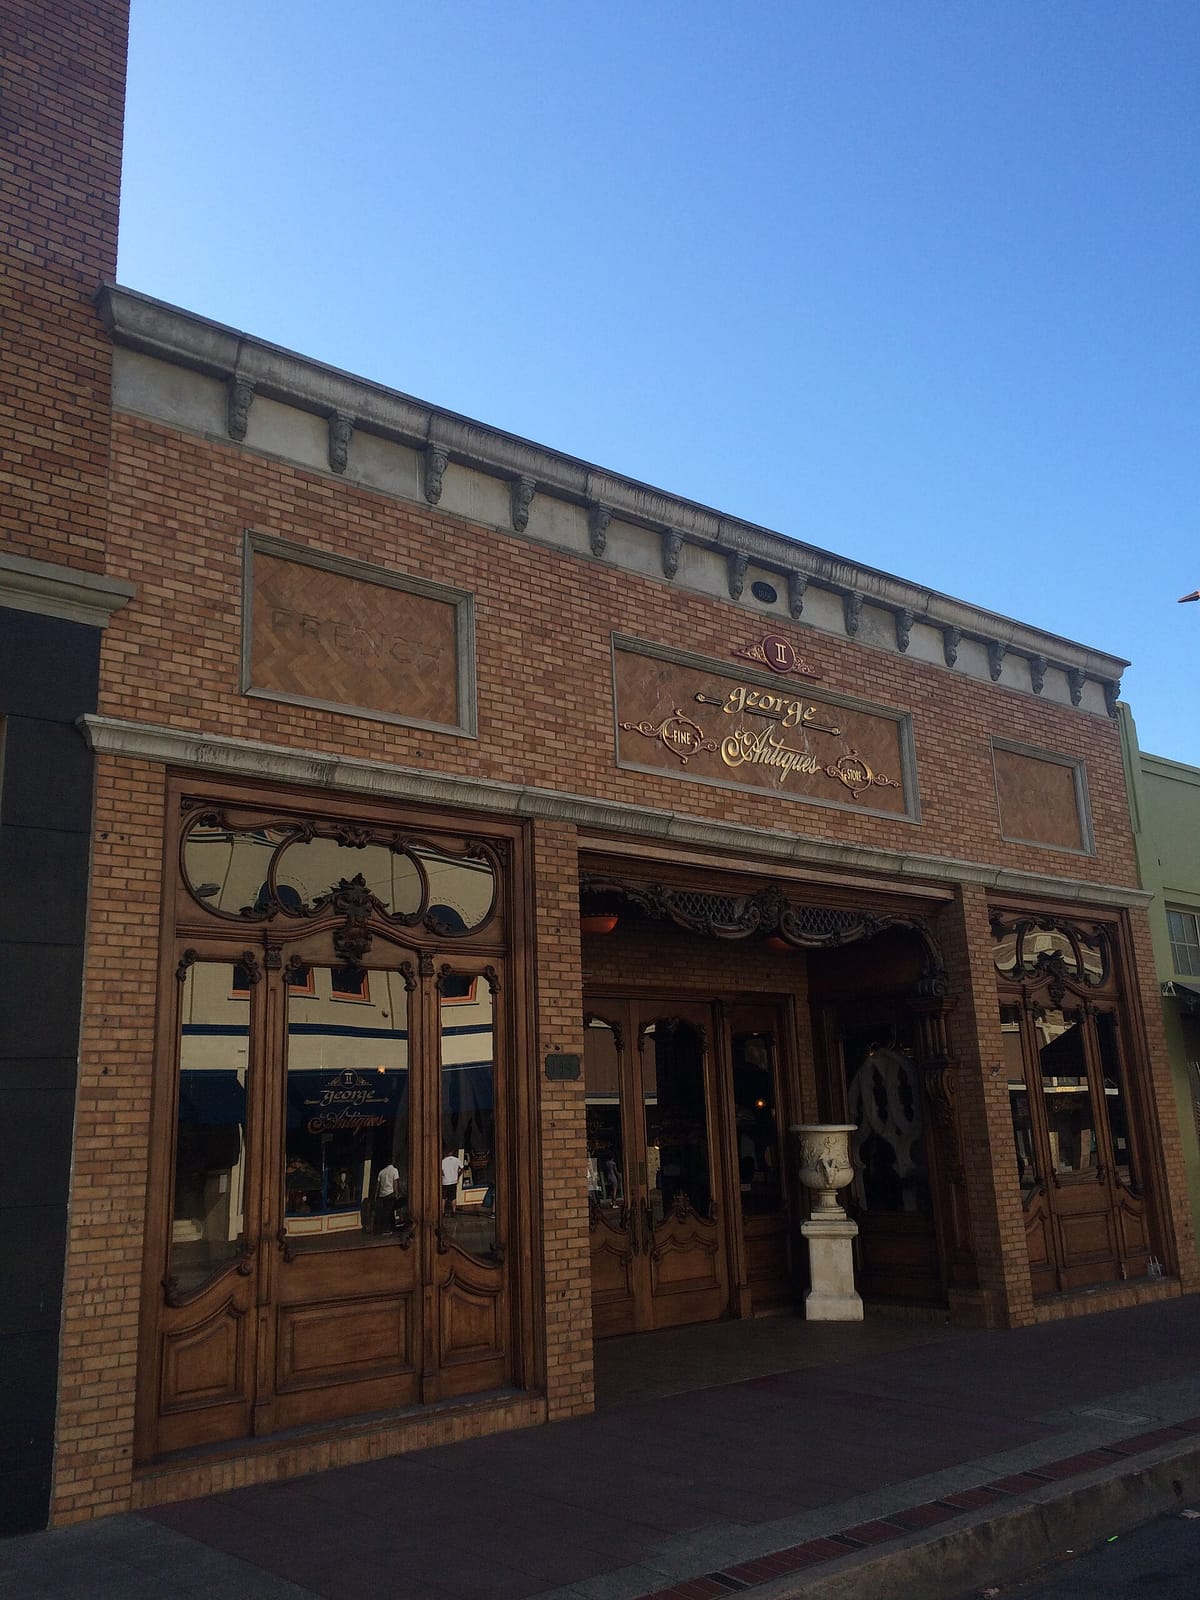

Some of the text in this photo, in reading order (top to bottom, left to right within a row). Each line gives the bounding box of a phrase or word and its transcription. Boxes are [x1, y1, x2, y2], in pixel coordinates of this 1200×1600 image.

[723, 687, 817, 728] george
[673, 729, 691, 745] FINE
[721, 724, 821, 782] Antiques
[319, 1089, 376, 1107] george
[306, 1106, 387, 1136] Antiques
